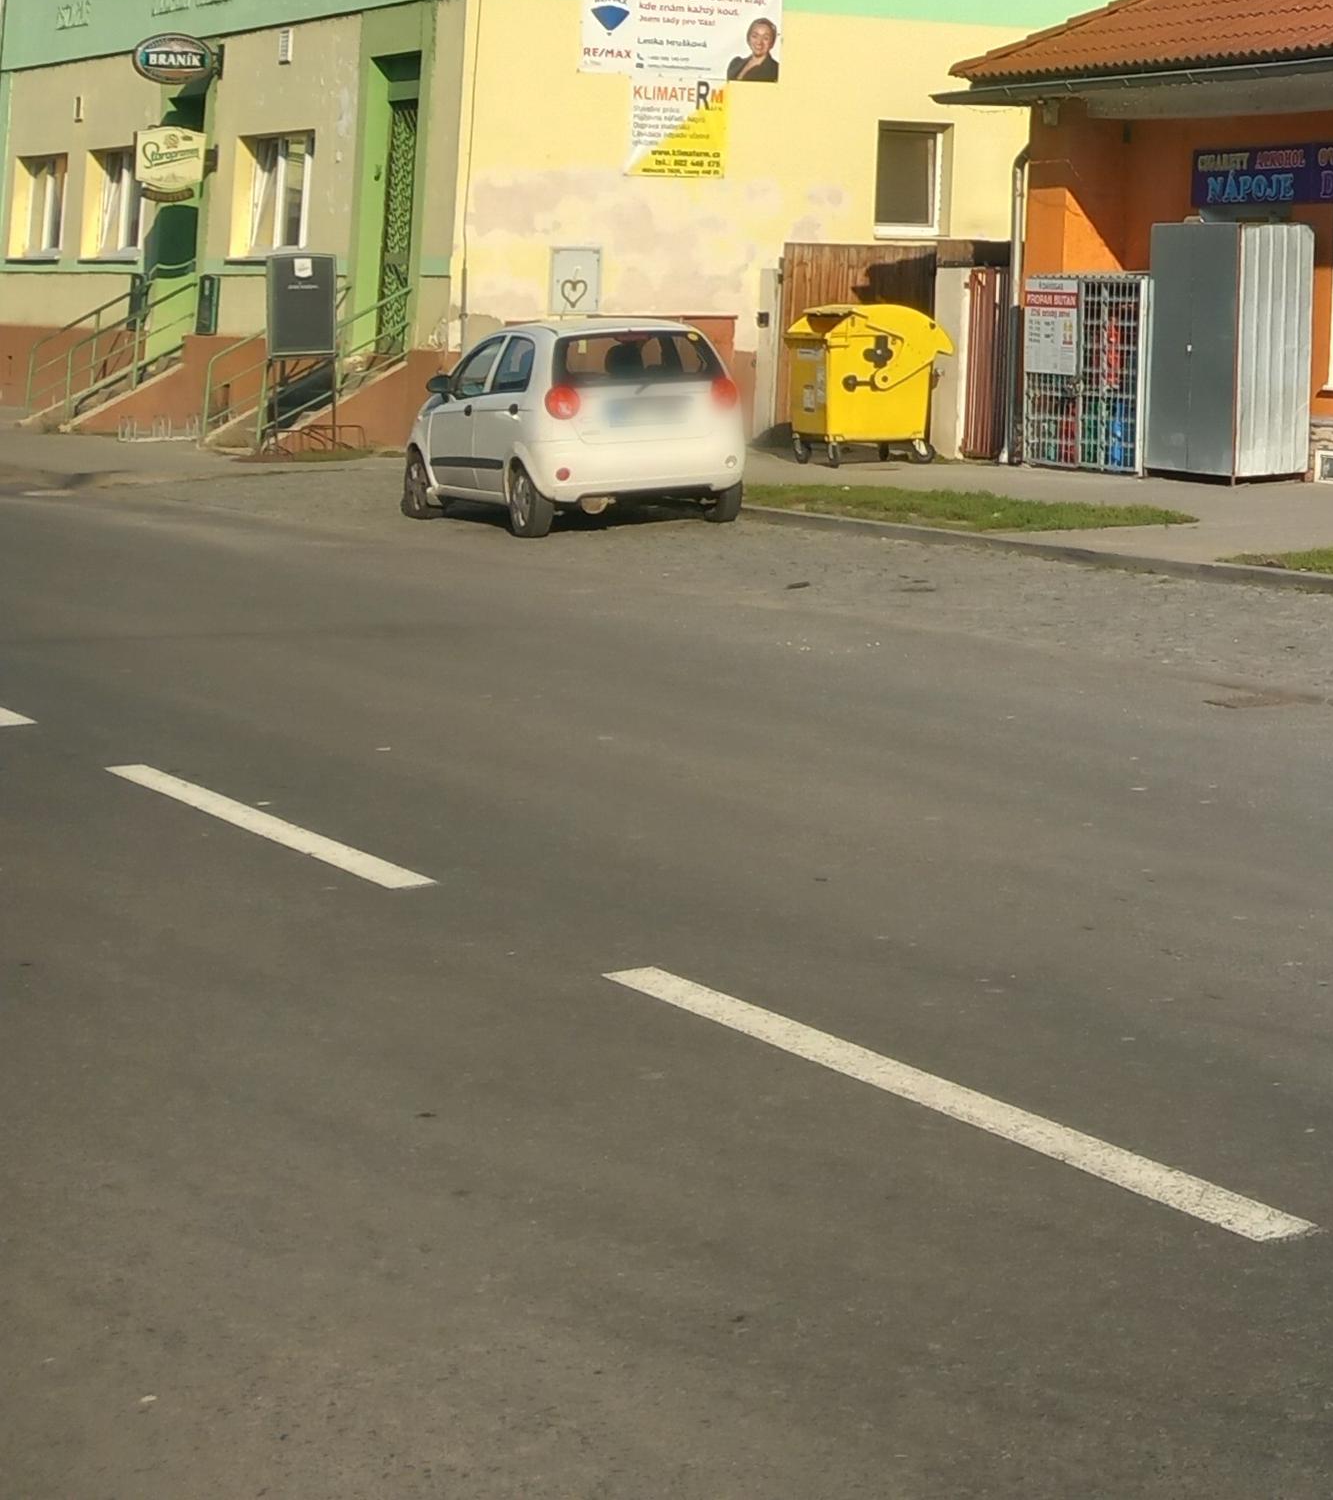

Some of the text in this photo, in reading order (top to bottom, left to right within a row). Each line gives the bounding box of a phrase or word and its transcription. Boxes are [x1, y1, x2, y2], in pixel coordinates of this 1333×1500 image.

[149, 53, 201, 66] BRANÍK
[583, 47, 632, 59] RE/MAX
[633, 80, 724, 110] KLIMATERM
[1255, 149, 1305, 169] ALKOHOL
[1207, 169, 1294, 203] NÁPOJE
